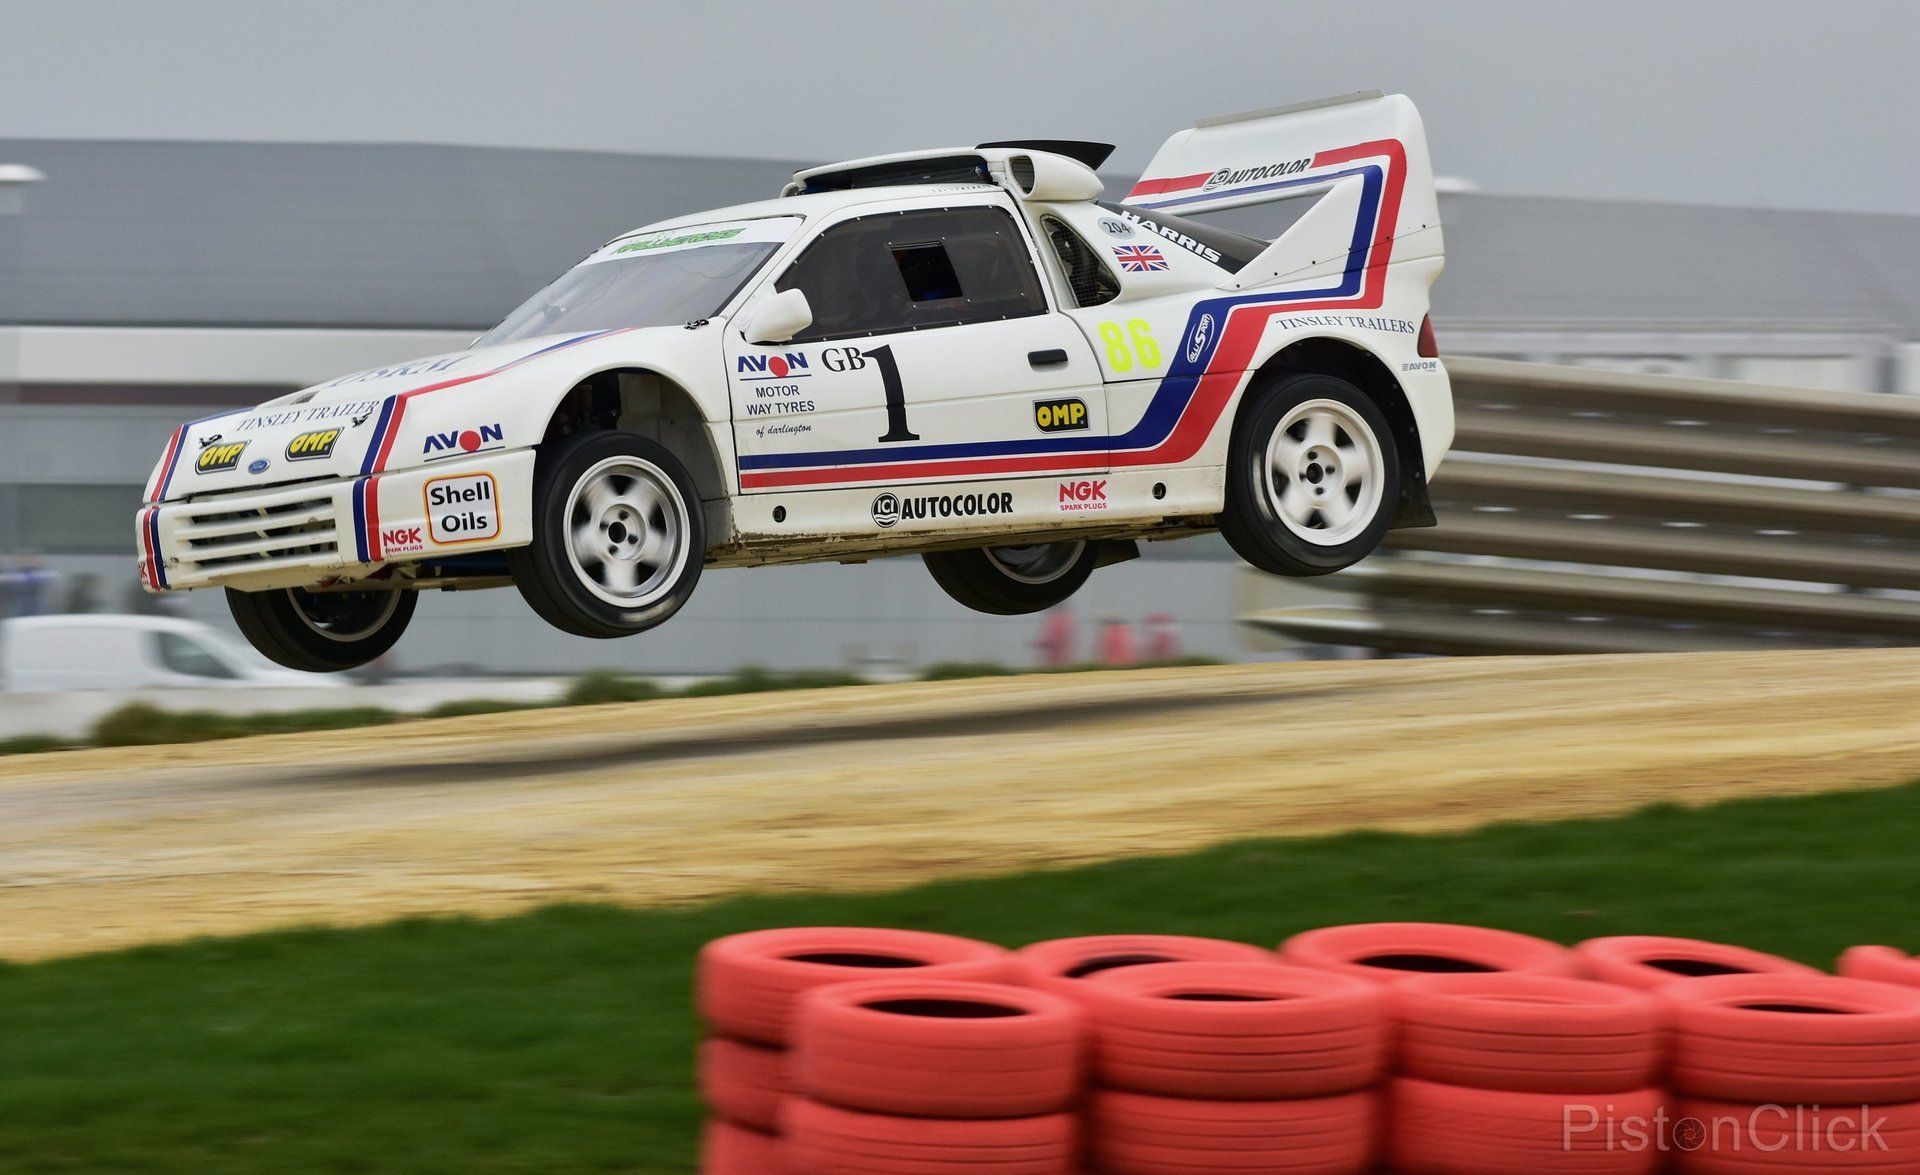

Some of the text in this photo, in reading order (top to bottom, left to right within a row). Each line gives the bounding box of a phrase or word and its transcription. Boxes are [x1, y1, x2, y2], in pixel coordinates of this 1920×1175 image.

[1224, 158, 1311, 186] AUTOCOLOR
[1102, 220, 1130, 234] 204
[1119, 210, 1222, 264] HARRIS
[1276, 315, 1415, 335] TINSLEY TRAILERS
[1098, 317, 1163, 373] 86
[821, 346, 866, 373] GB
[1409, 361, 1436, 371] AVON
[755, 385, 800, 398] MOTOR
[861, 344, 920, 443] 1
[237, 408, 306, 432] TINSLEY
[746, 400, 815, 416] WAY TYRES
[1036, 402, 1085, 428] OMP
[290, 429, 338, 454] OMP
[755, 424, 812, 438] of darlington
[200, 441, 245, 468] OMP
[430, 480, 491, 506] Shell
[1059, 480, 1107, 503] NGK
[901, 492, 1014, 520] AUTOCOLOR
[1083, 502, 1107, 510] PLUGS
[441, 511, 488, 533] Oils
[382, 526, 422, 547] NGK
